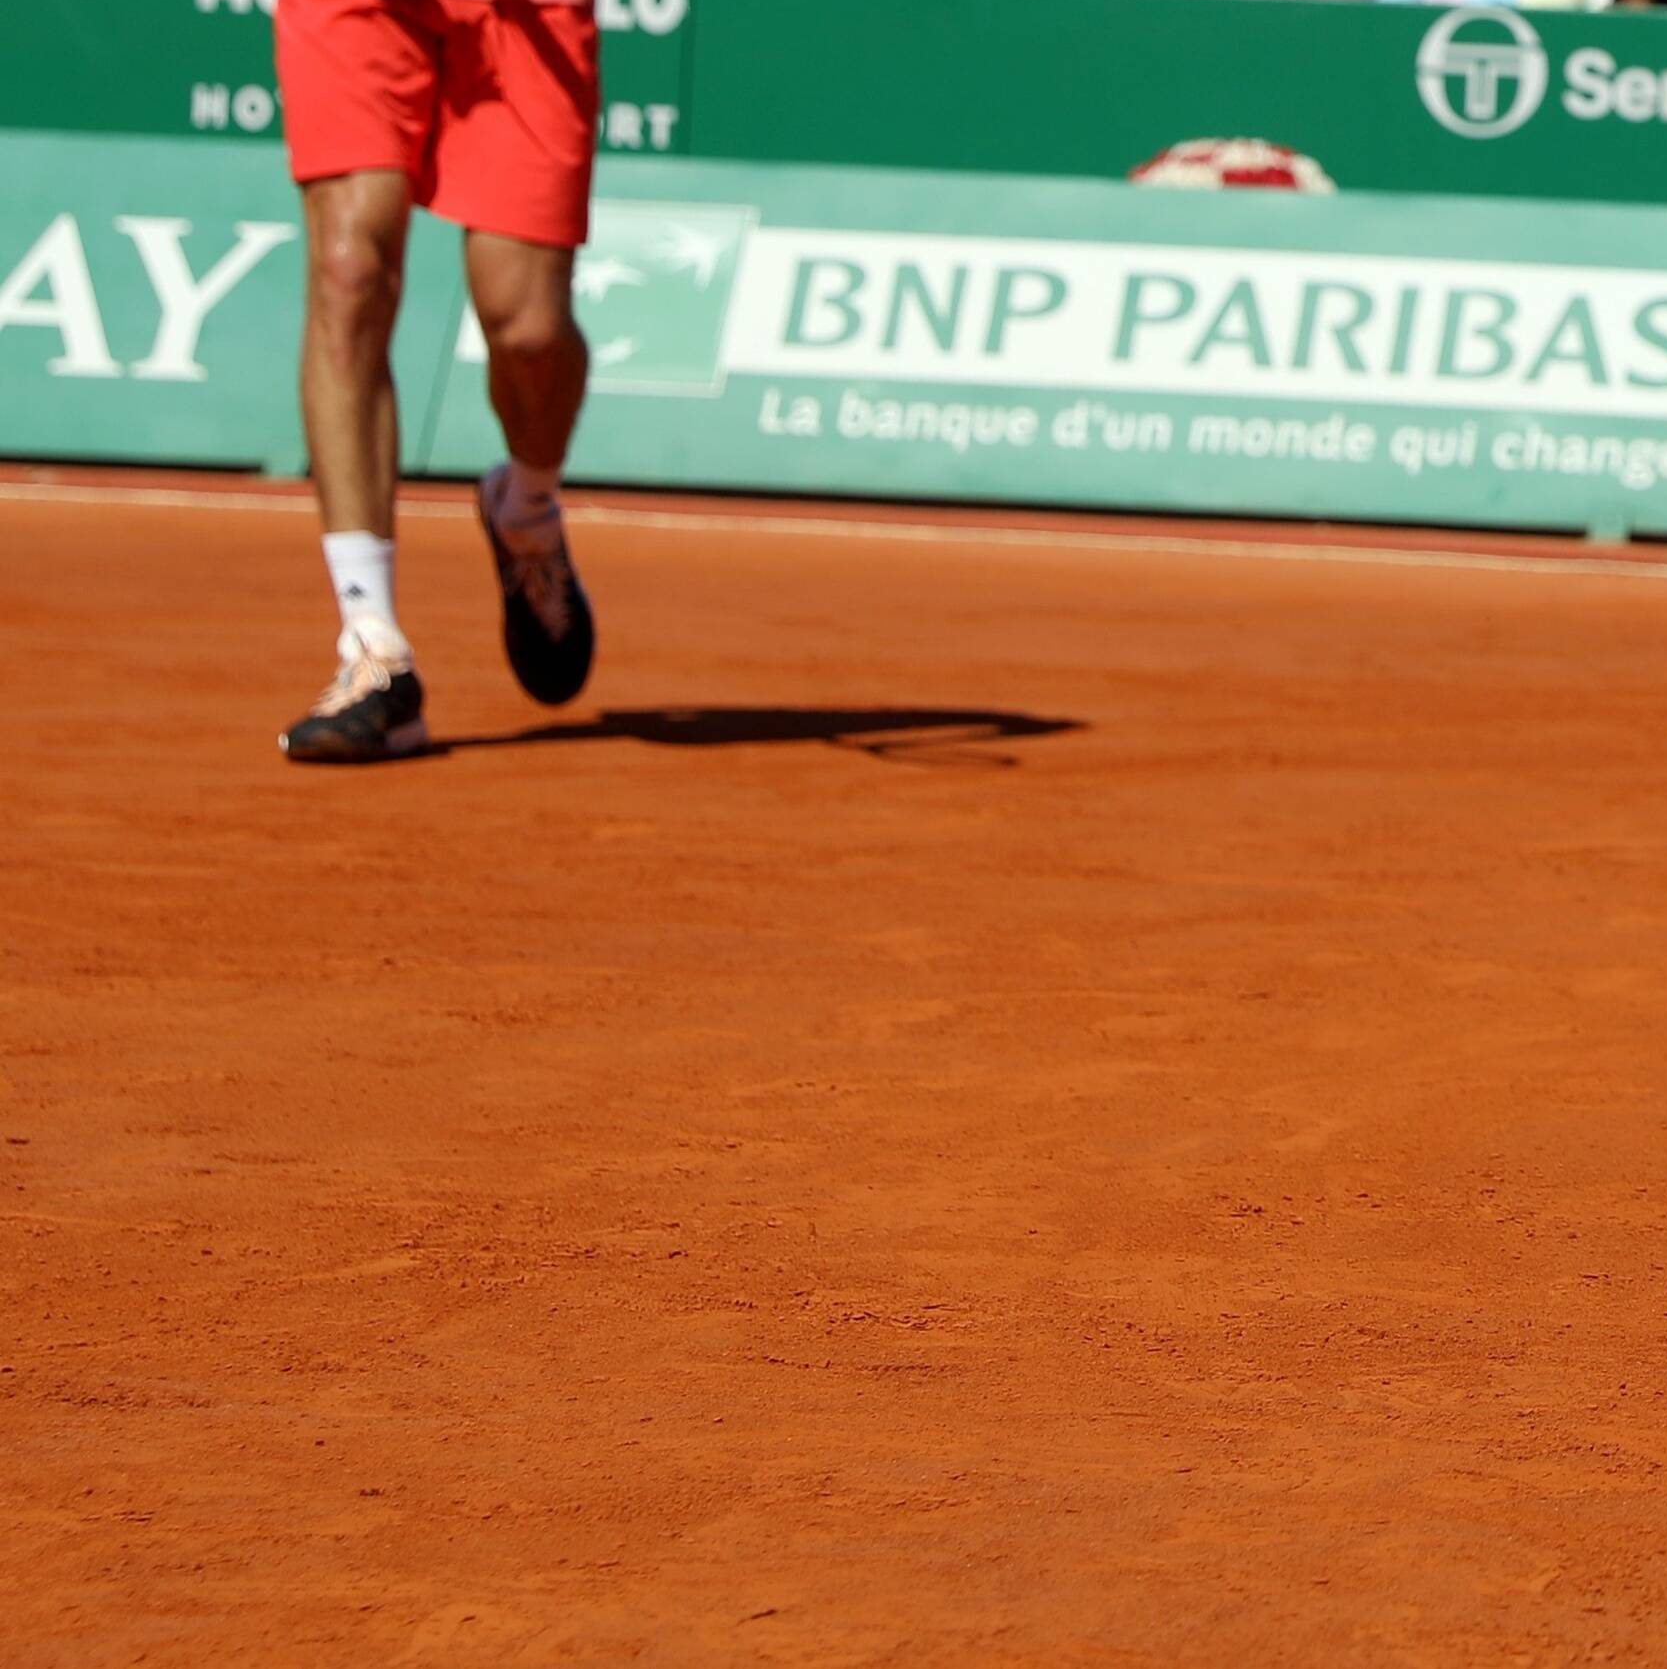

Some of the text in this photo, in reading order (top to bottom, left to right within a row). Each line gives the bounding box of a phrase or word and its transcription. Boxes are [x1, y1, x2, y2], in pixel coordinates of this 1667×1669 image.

[782, 255, 1072, 357] BNP
[760, 387, 822, 437] La
[836, 391, 1038, 449] banque
[1052, 393, 1172, 453] d'un
[1188, 413, 1376, 465] monde
[1390, 423, 1478, 471] qui
